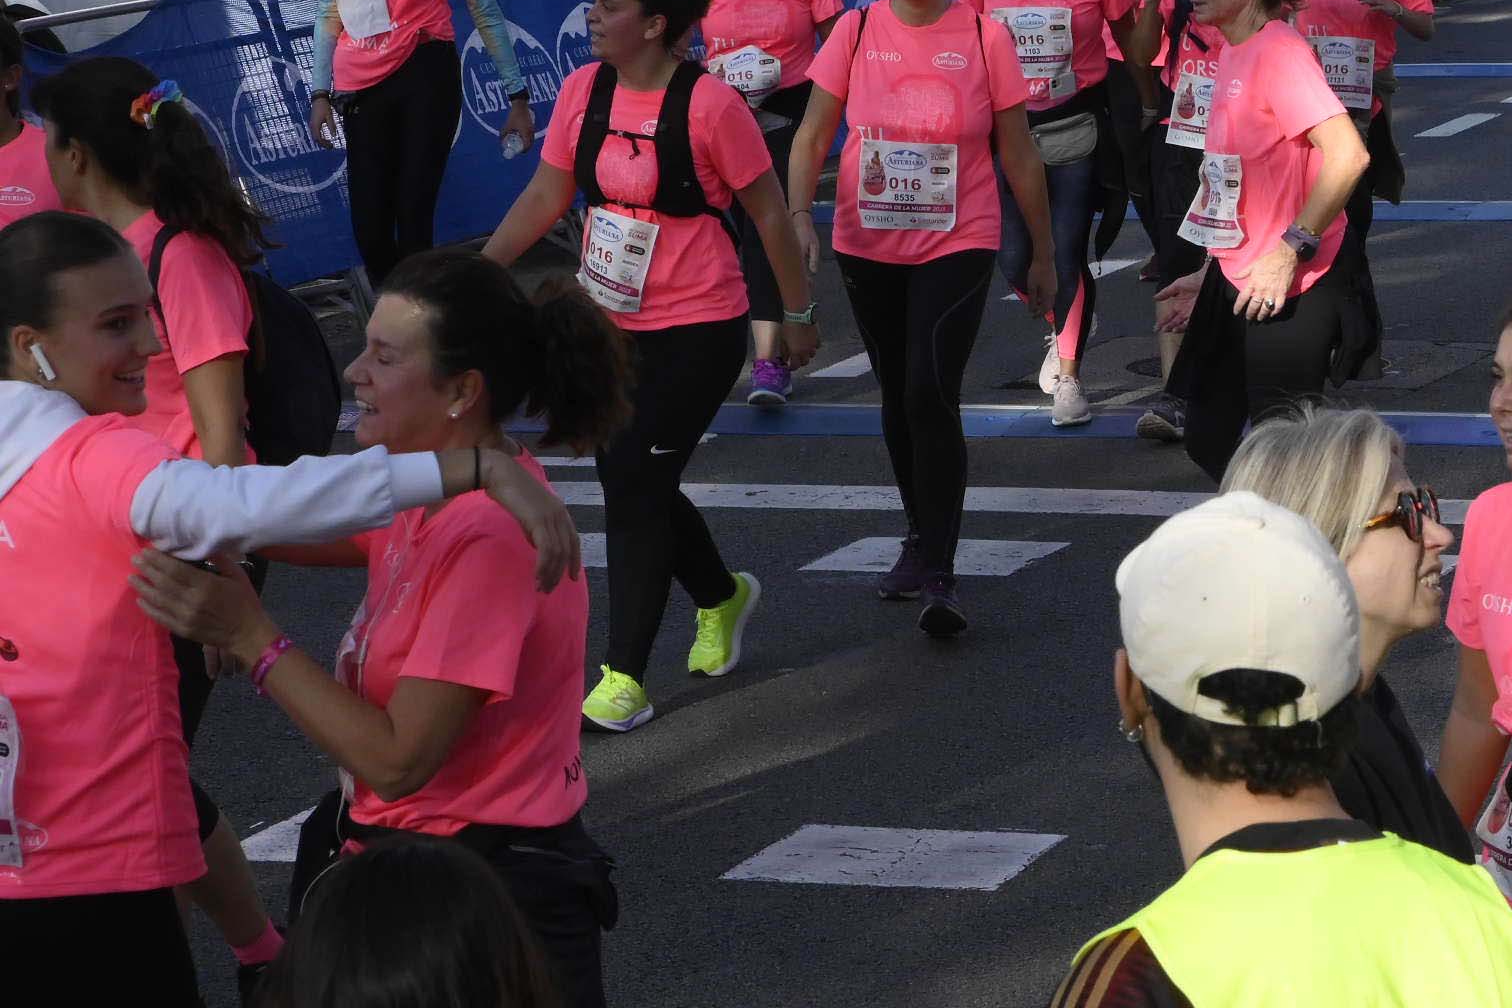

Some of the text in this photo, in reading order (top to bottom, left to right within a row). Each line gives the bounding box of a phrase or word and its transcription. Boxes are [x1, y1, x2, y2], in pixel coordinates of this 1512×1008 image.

[1018, 34, 1045, 45] 016
[866, 50, 902, 62] OYSHO
[1325, 64, 1349, 74] 016
[727, 70, 753, 81] 016
[888, 156, 923, 165] ASTURIANA
[889, 177, 922, 191] 016
[894, 194, 915, 202] 8535
[864, 215, 894, 223] OYSHO
[591, 242, 613, 264] 016
